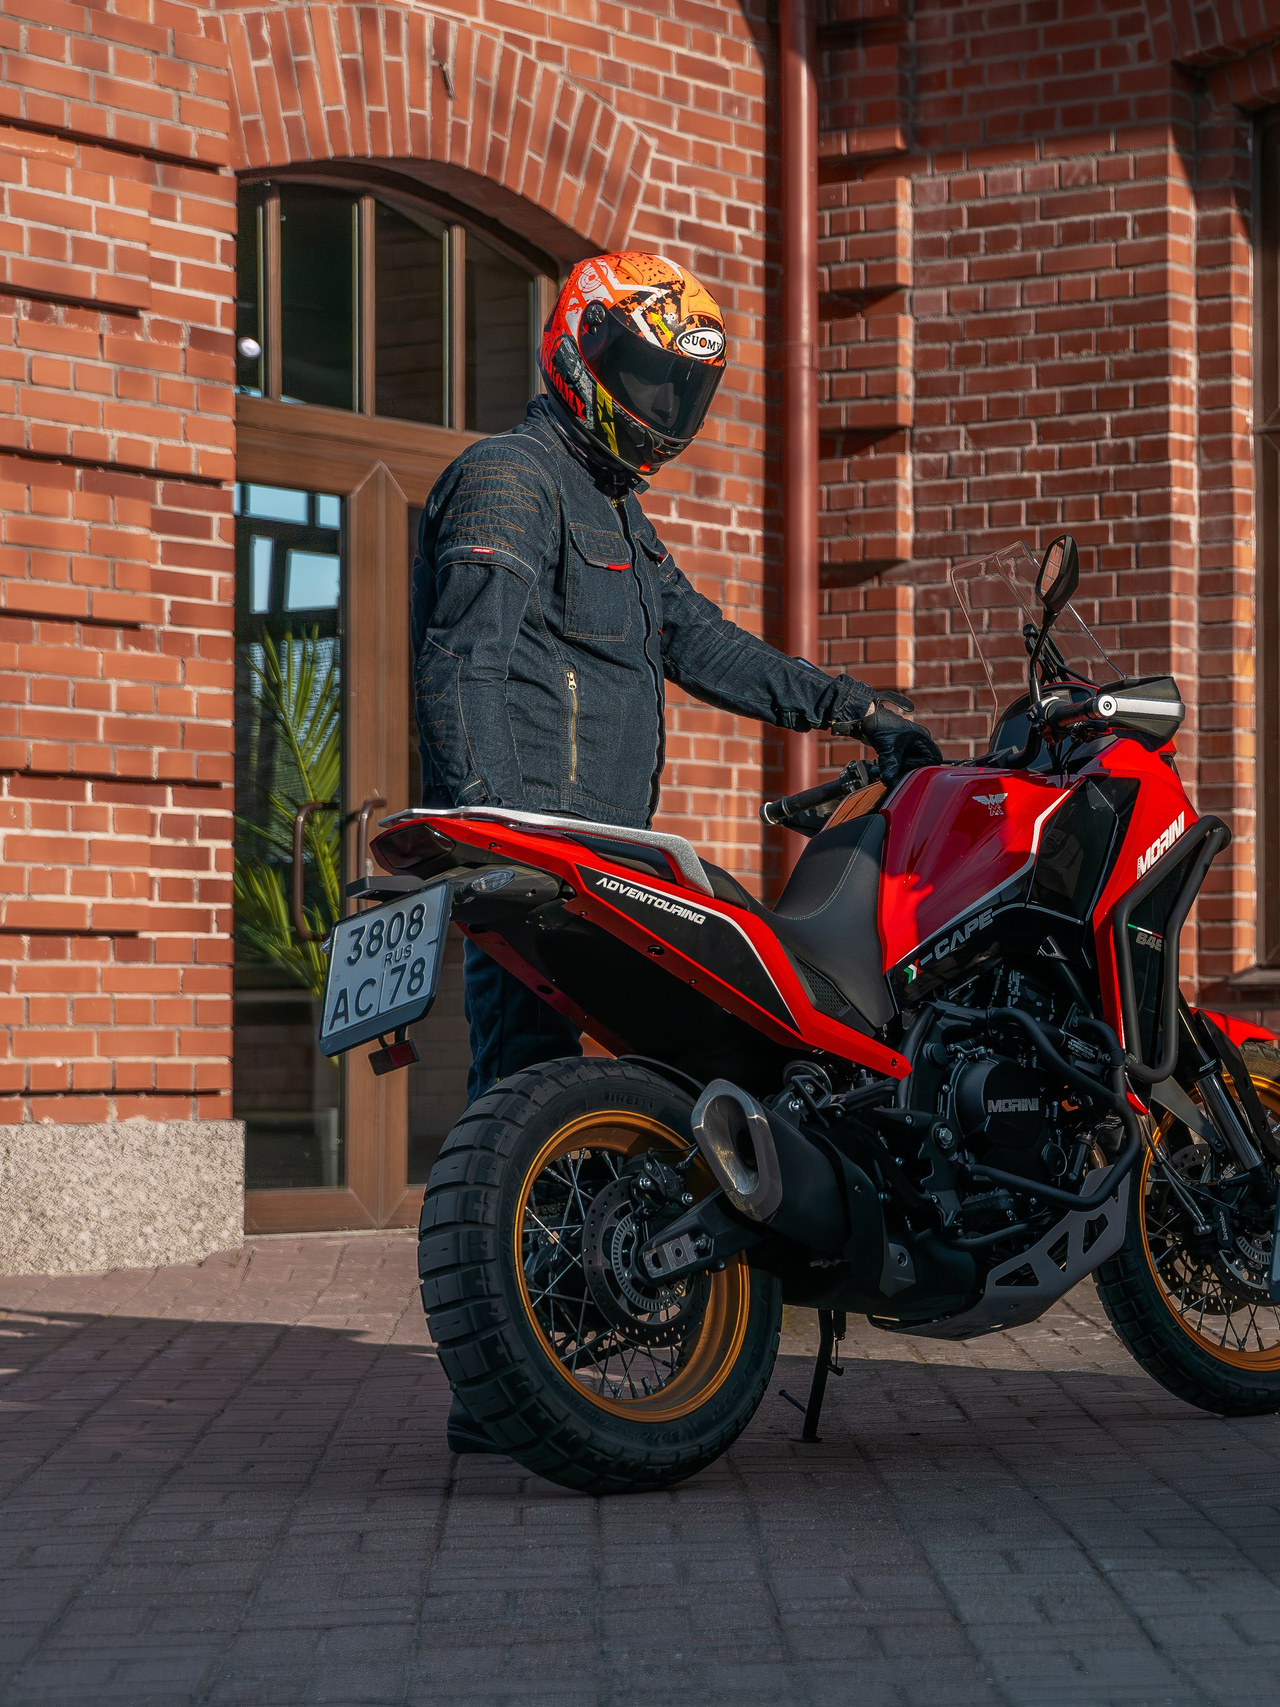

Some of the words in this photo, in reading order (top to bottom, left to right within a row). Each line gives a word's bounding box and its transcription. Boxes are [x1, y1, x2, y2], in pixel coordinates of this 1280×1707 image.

[1137, 810, 1185, 880] MORINI
[596, 877, 707, 925] ADVENTOURING
[346, 902, 426, 967] 3808
[383, 943, 414, 969] RUS
[329, 977, 377, 1032] AC
[387, 956, 427, 1006] 78
[987, 1097, 1040, 1113] MORINI
